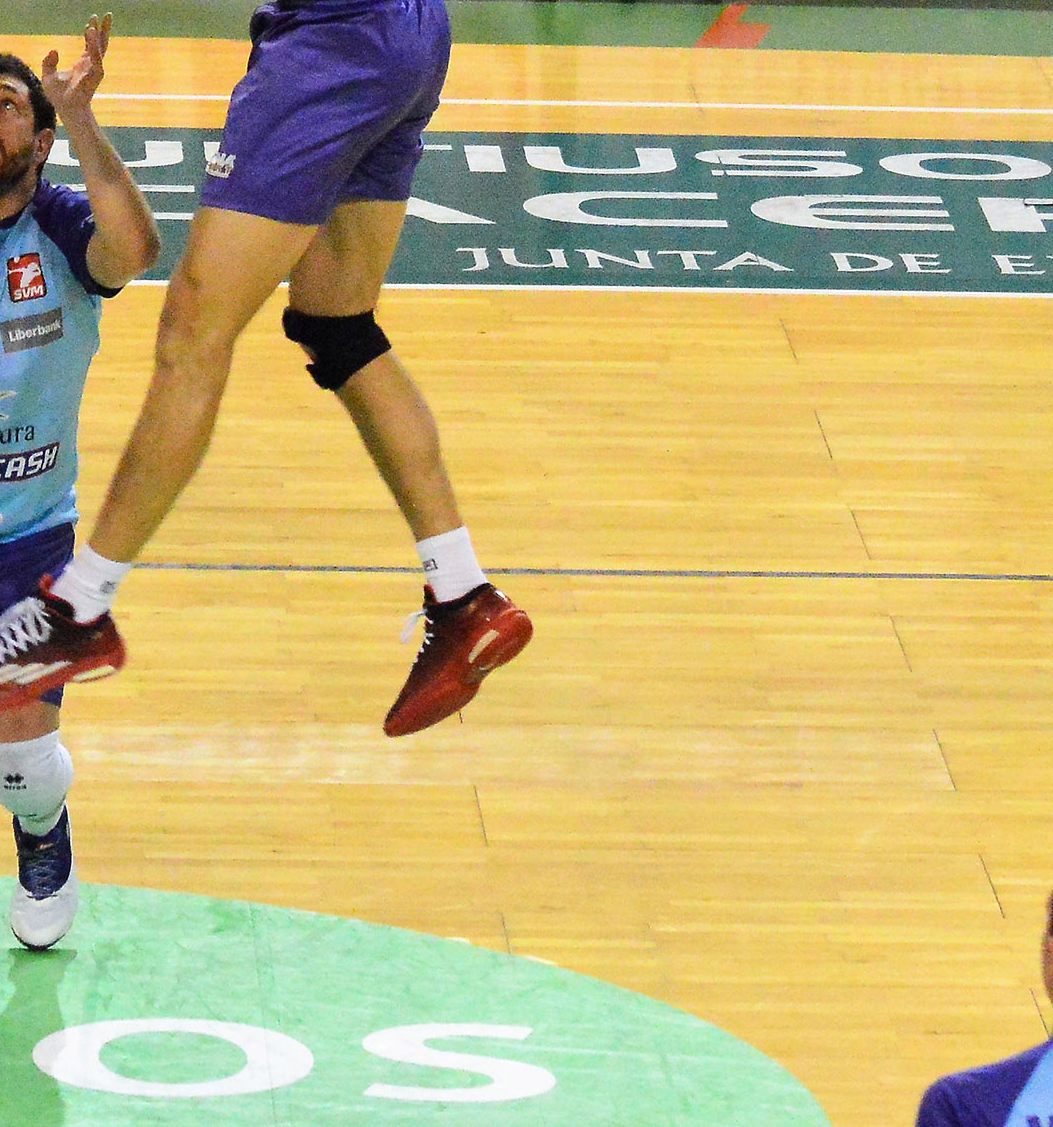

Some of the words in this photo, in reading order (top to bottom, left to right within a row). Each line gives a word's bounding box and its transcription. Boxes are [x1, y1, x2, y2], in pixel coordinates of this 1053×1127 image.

[455, 247, 795, 273] JUNTA
[830, 252, 952, 275] DE
[992, 254, 1053, 276] E
[13, 285, 45, 301] SVM
[8, 319, 62, 343] Liberbank
